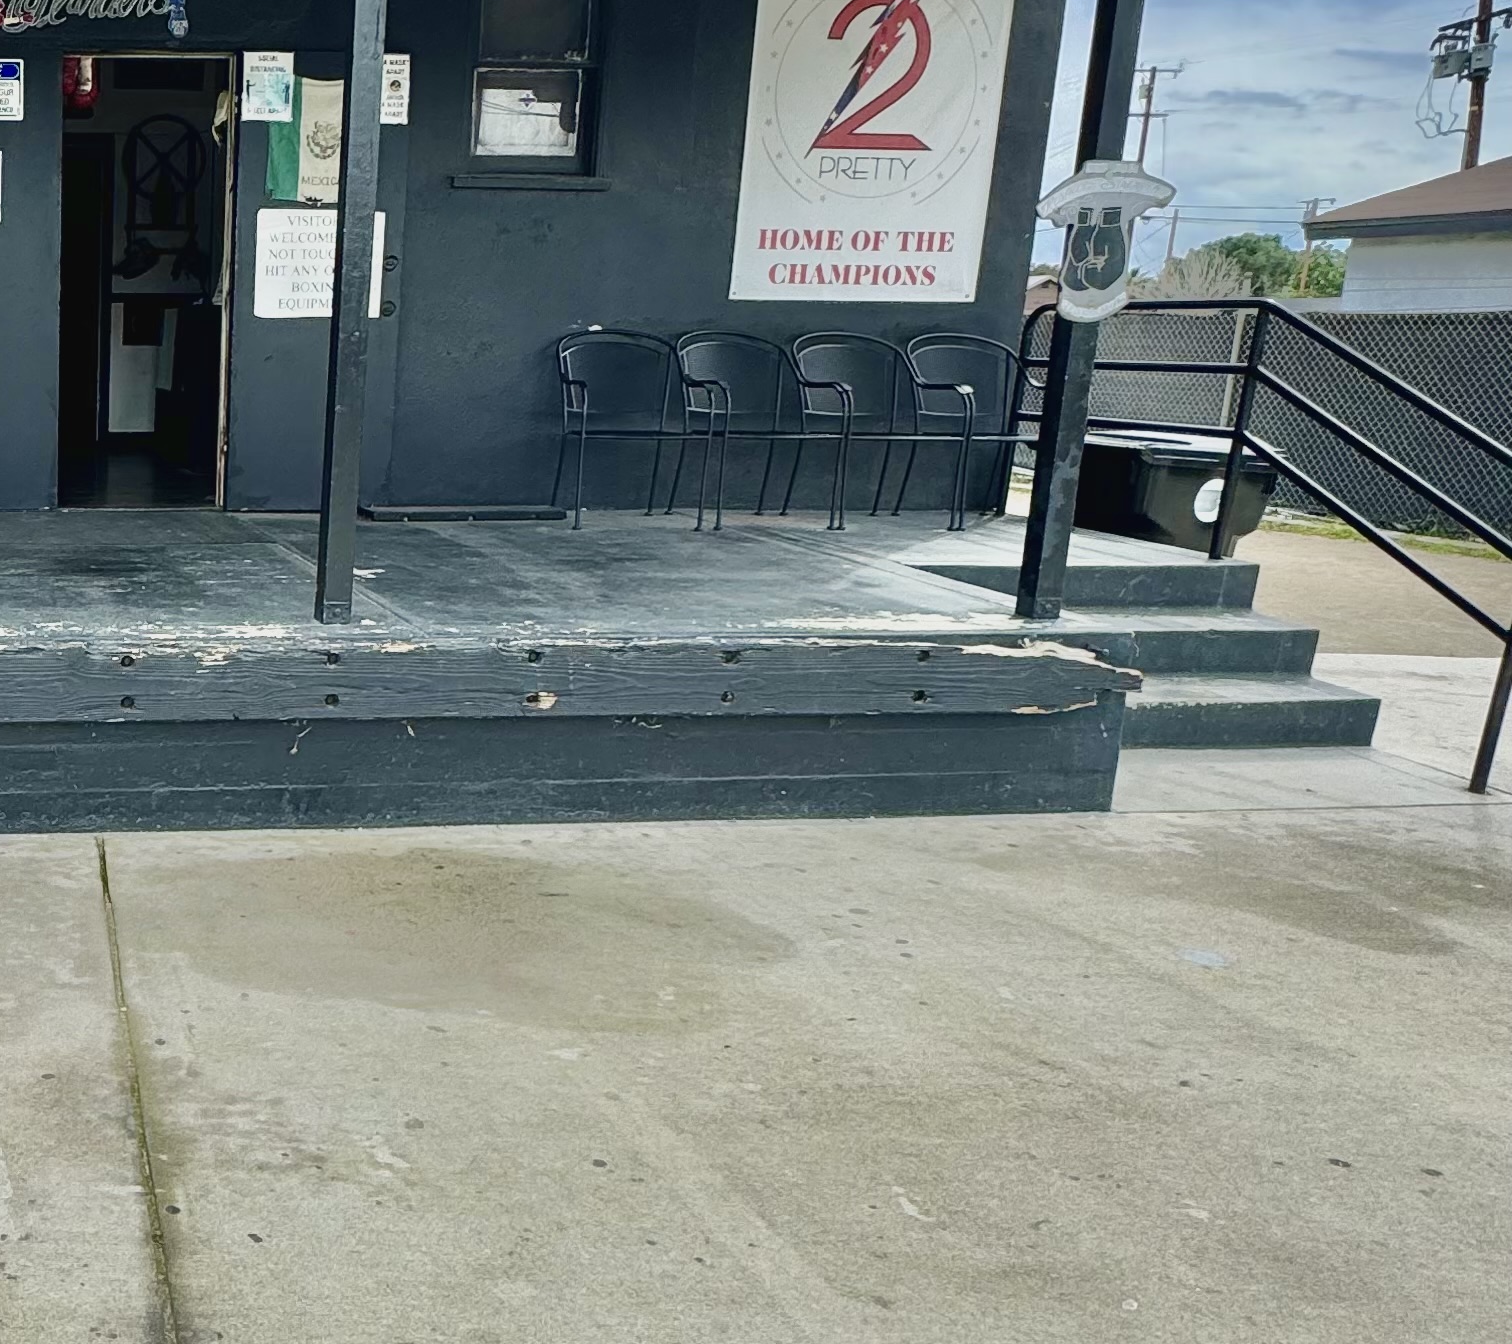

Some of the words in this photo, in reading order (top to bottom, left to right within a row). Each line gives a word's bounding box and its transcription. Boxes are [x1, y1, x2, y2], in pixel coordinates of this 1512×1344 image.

[818, 156, 917, 182] PRETTY
[300, 175, 339, 186] MEXIC
[269, 232, 336, 244] WELCOME
[758, 229, 843, 251] HOME
[850, 230, 888, 252] OF
[896, 231, 955, 253] THE
[268, 248, 297, 260] NOT
[301, 249, 336, 260] TOUC
[265, 265, 289, 276] HIT
[292, 266, 319, 276] ANY
[768, 263, 936, 287] CHAMPIONS
[291, 281, 334, 293] BOXIN
[278, 298, 330, 311] EQUIPM
